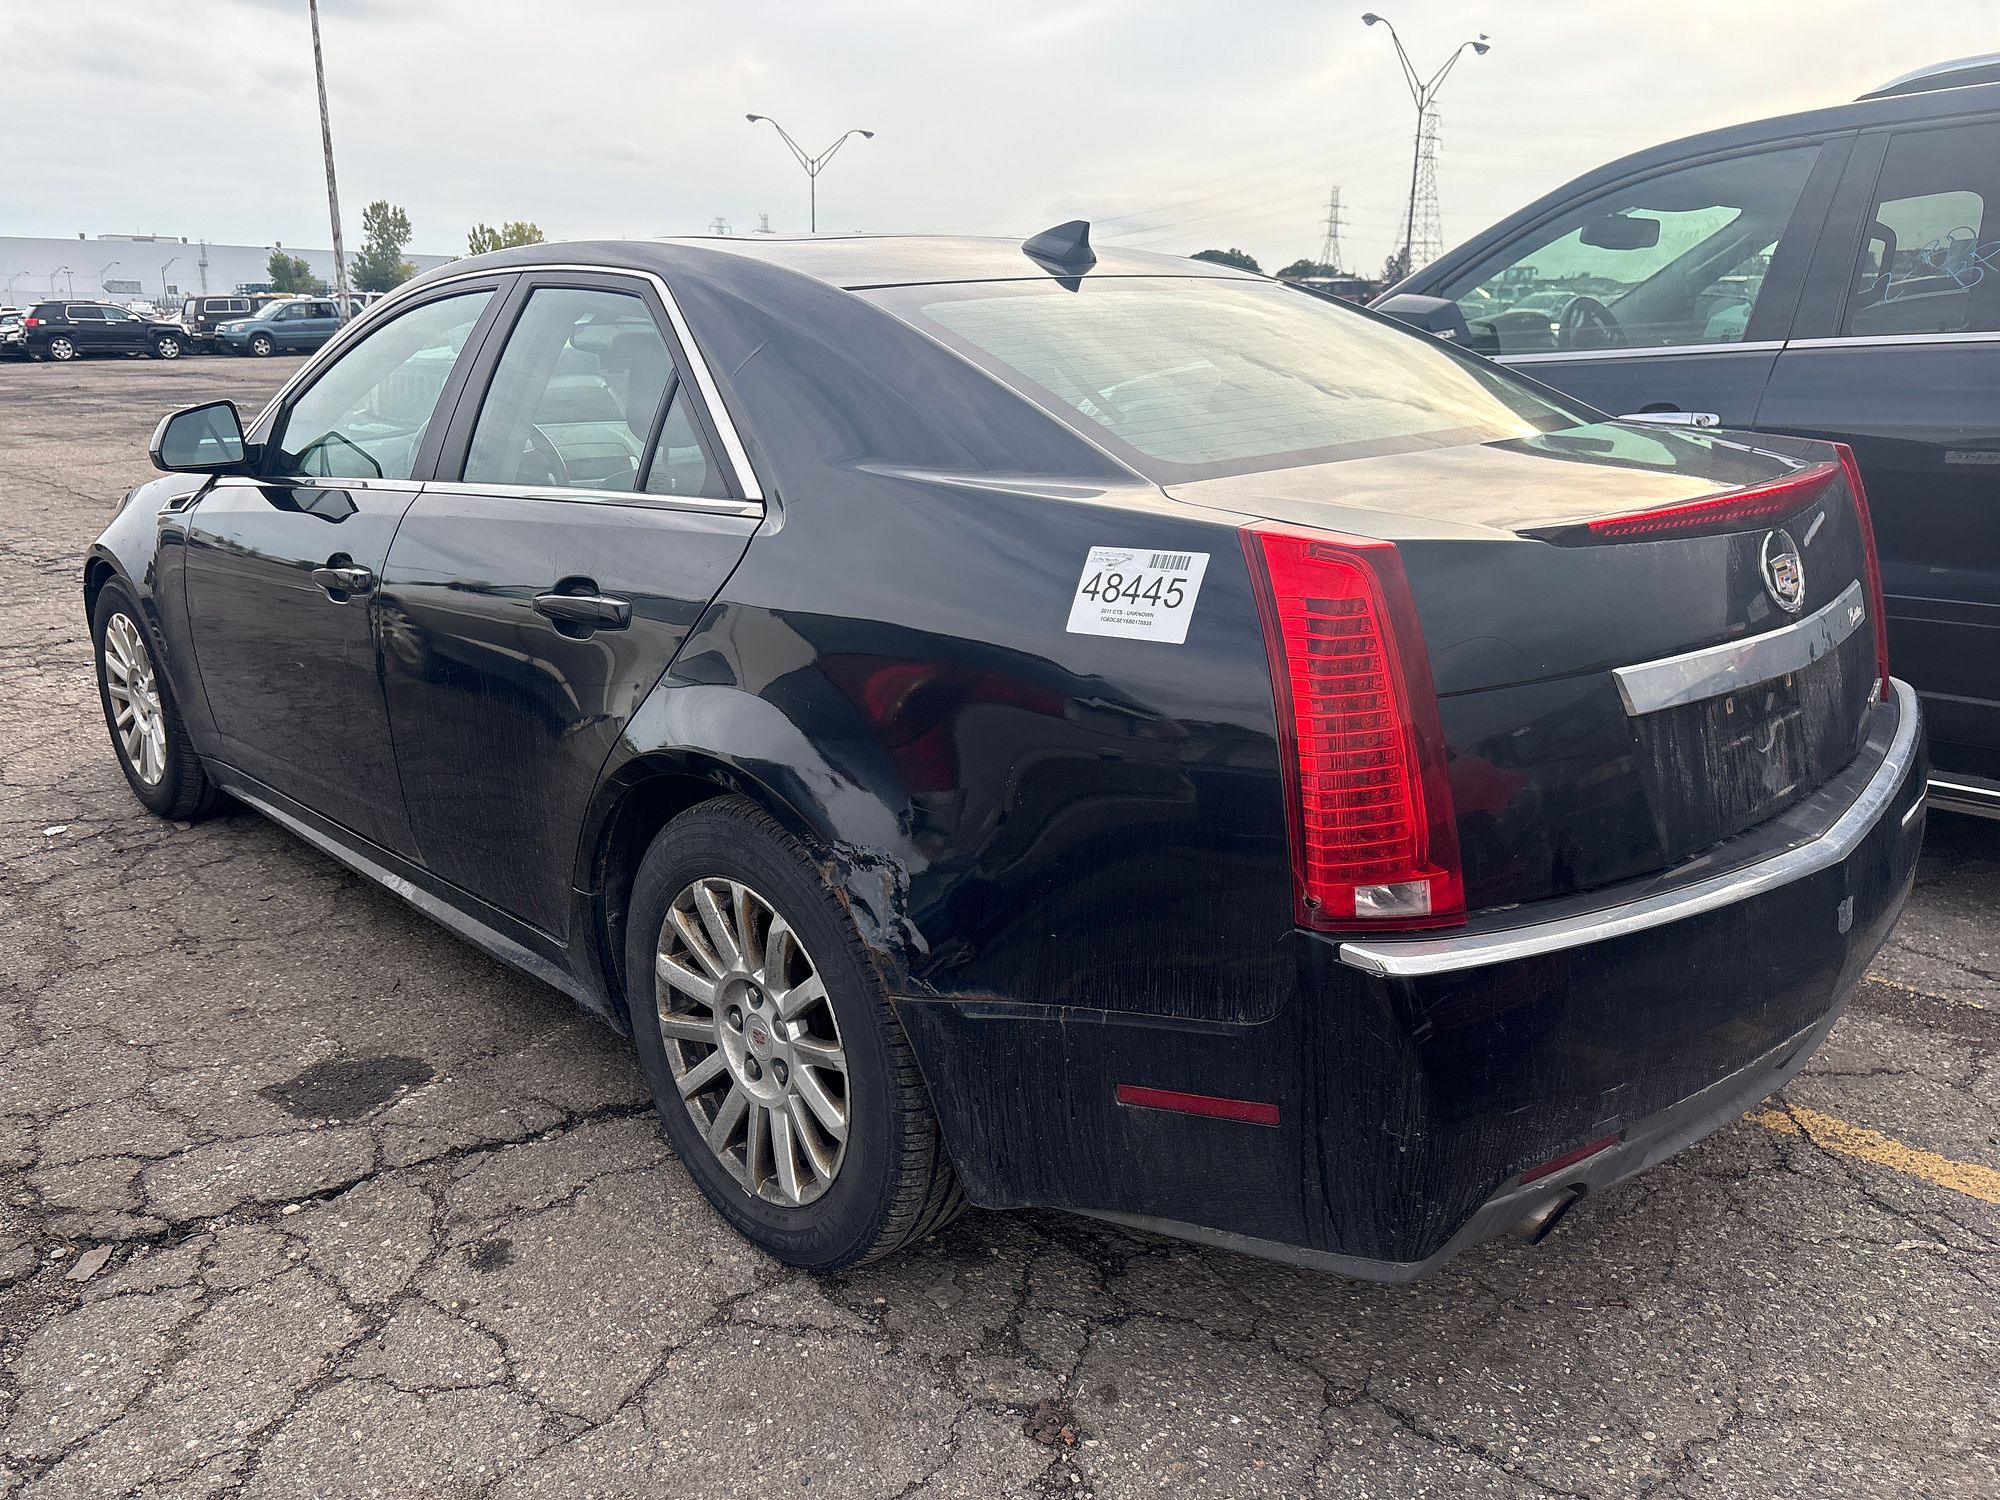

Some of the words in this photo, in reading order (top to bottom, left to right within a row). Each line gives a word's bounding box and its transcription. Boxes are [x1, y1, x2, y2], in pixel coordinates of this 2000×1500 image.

[1081, 571, 1188, 609] 48445
[1112, 608, 1123, 616] CTS
[1126, 610, 1155, 618] UNKNOWN
